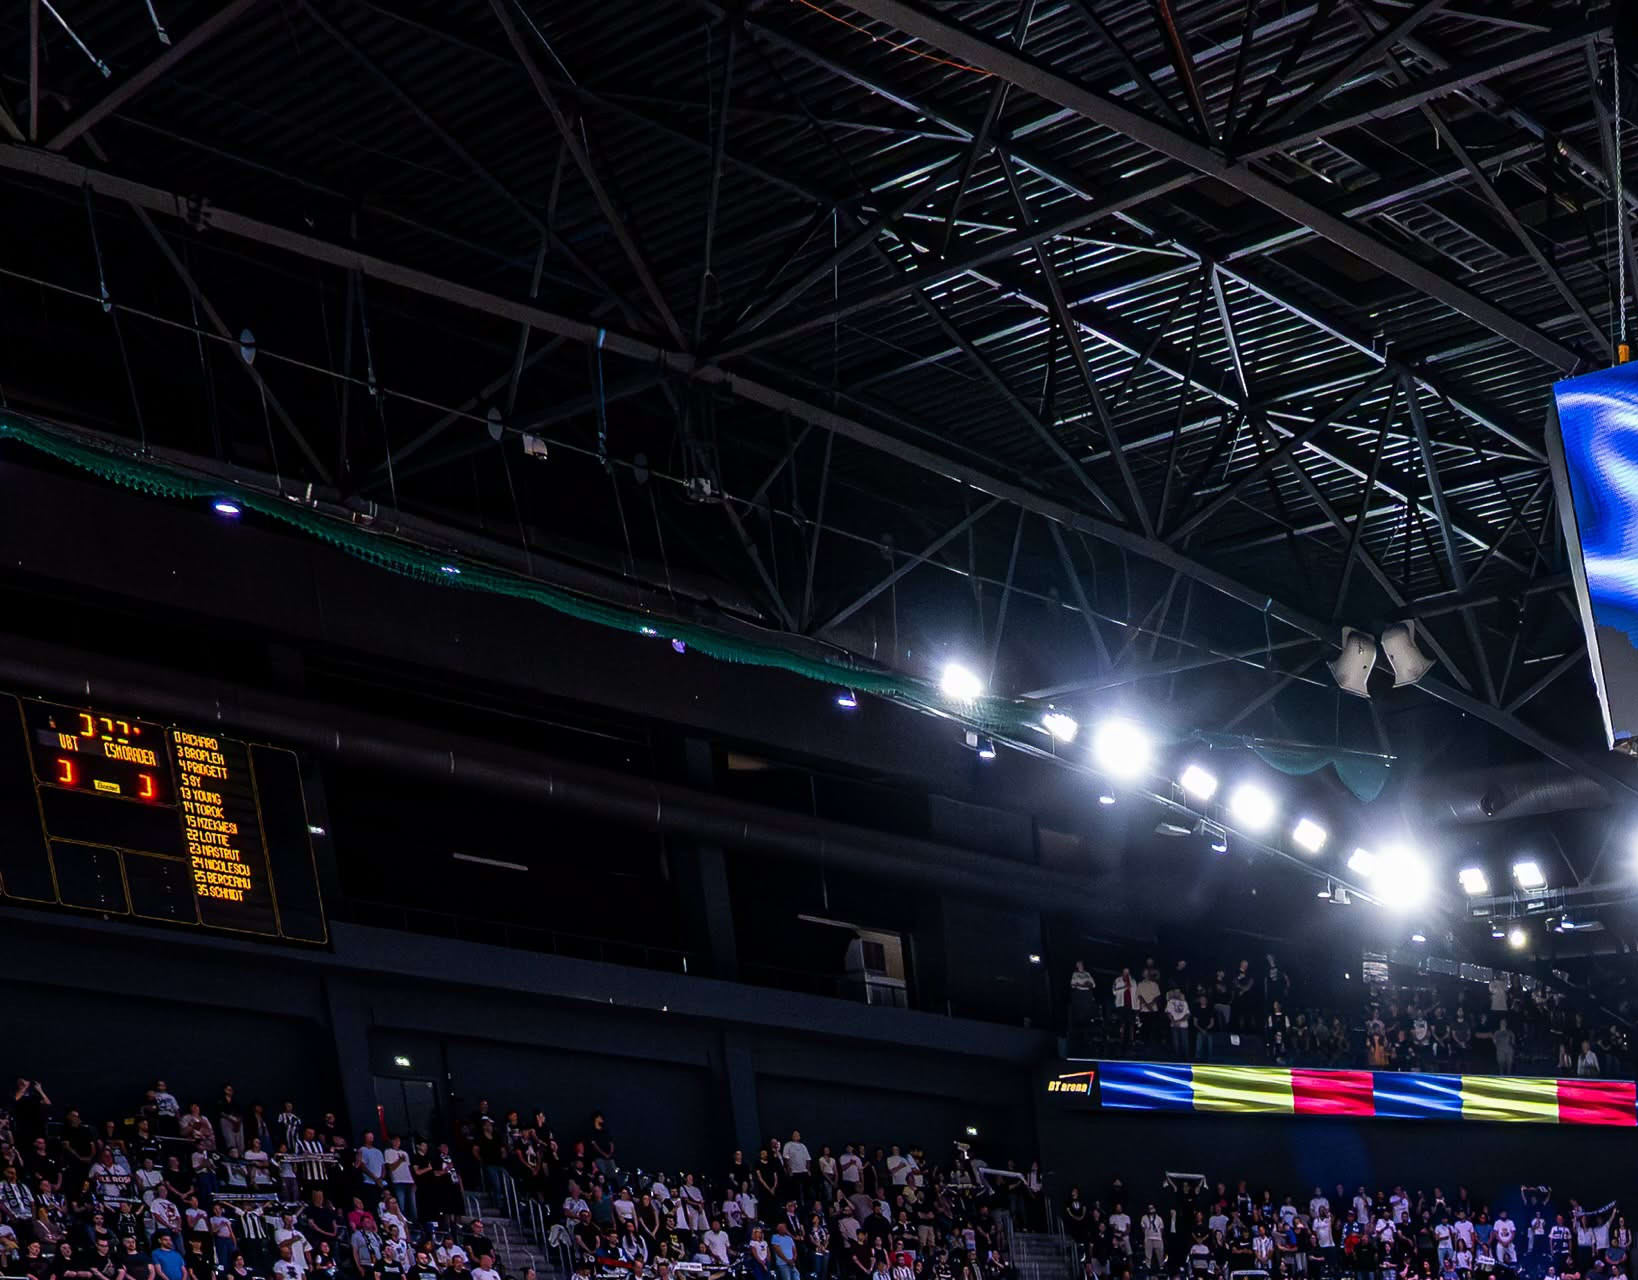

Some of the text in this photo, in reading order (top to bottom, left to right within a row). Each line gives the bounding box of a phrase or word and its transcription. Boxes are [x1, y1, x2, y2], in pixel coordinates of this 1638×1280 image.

[182, 732, 218, 751] RICHARD
[176, 745, 184, 757] 3
[178, 759, 228, 779] 4 PRIDGETT
[181, 773, 189, 786] 5
[180, 786, 222, 805] 13 YOUNG
[182, 801, 224, 819] 14 TOROK
[185, 814, 197, 827] 15
[185, 828, 198, 841] 22
[189, 842, 201, 854] 23
[191, 856, 251, 876] 24 NICOLESCU
[193, 870, 206, 882] 25
[196, 884, 243, 901] 35 SCHMIDT
[1048, 1081, 1061, 1091] BT
